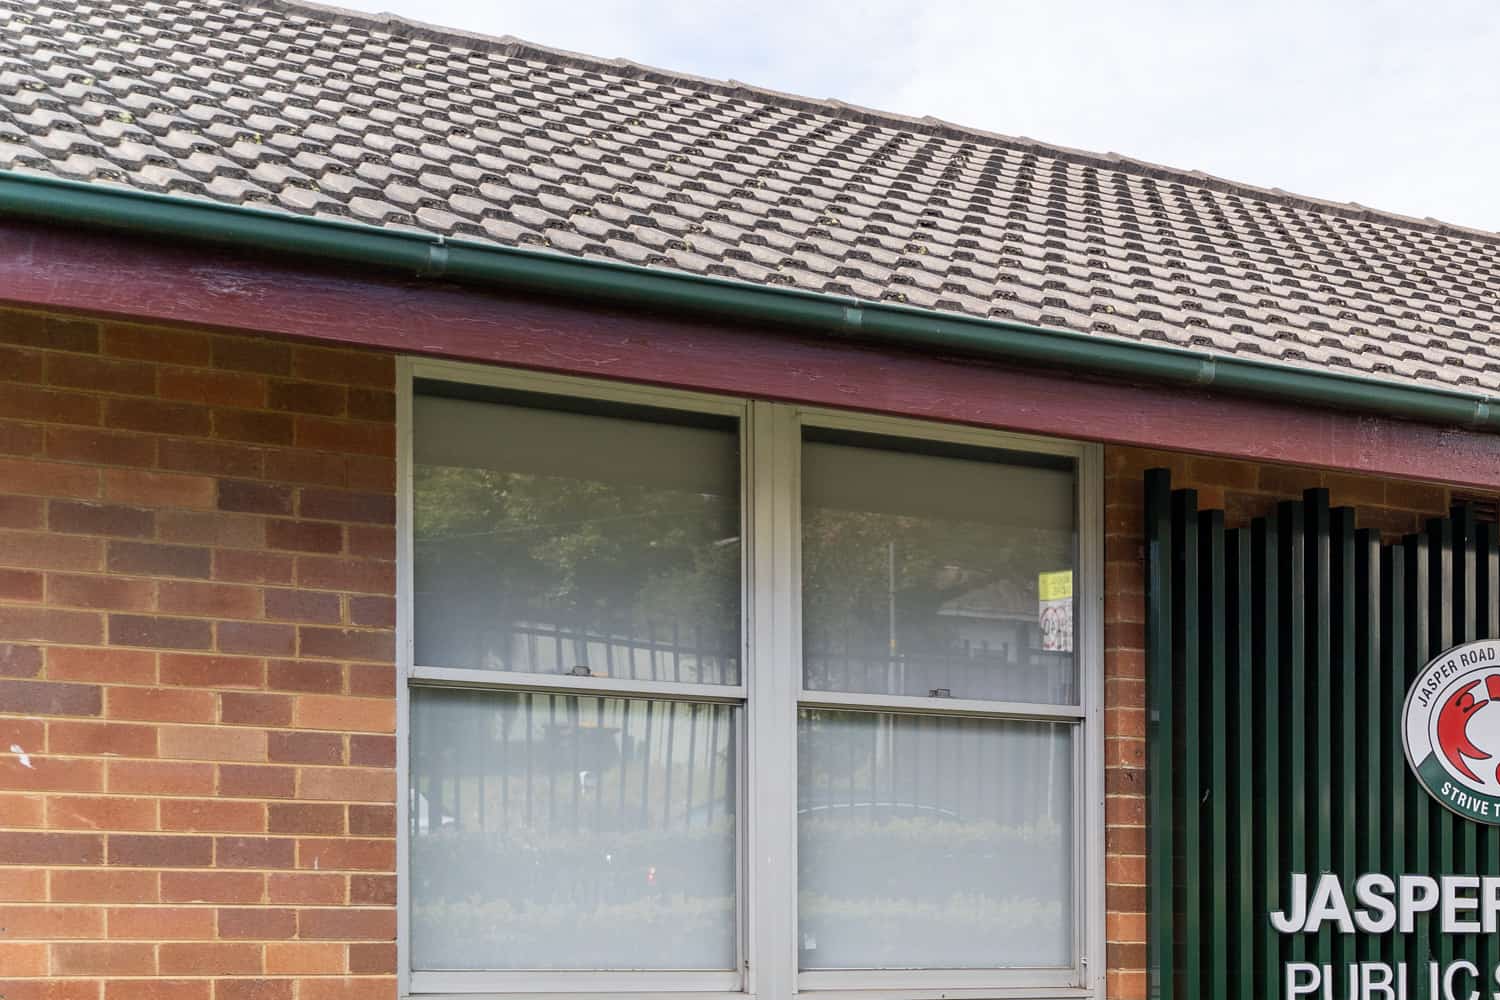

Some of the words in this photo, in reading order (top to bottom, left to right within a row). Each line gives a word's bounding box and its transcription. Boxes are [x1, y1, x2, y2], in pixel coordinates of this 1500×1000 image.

[1417, 660, 1458, 707] JASPER
[1460, 647, 1495, 667] ROAD
[1441, 782, 1489, 815] STRIVE
